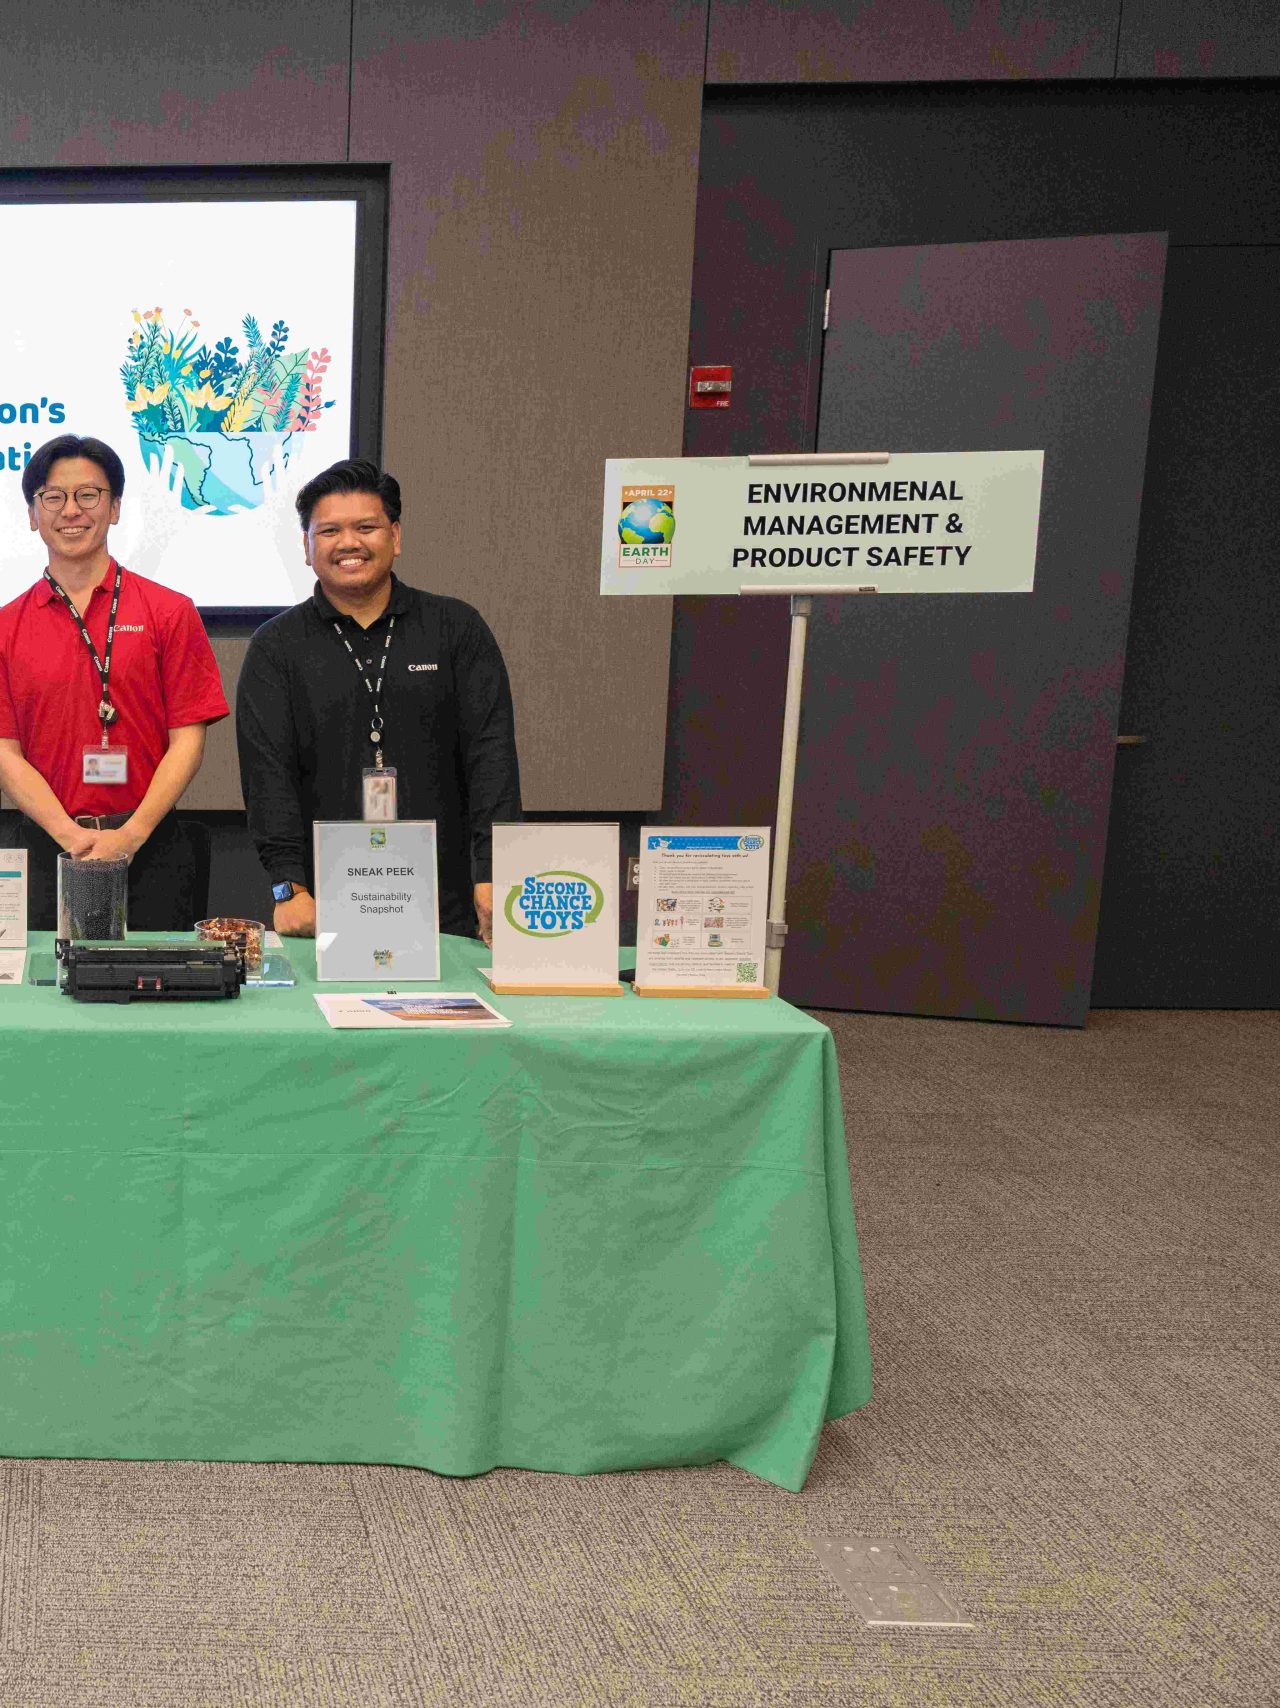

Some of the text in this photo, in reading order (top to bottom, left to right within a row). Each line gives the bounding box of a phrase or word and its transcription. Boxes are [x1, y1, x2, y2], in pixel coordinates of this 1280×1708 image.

[628, 489, 669, 497] APRIL 22
[747, 481, 964, 503] ENVIRONMENAL
[742, 513, 964, 536] MANAGEMENT &
[622, 546, 669, 557] EARTH
[732, 545, 973, 568] PRODUCT SAFETY
[114, 624, 144, 632] Canon
[408, 664, 438, 672] Canon
[347, 867, 415, 877] SNEAK PEEK
[351, 892, 412, 903] Sustainability
[519, 895, 592, 910] CHANCE
[359, 905, 404, 915] Snapshot
[525, 910, 584, 930] TOYS
